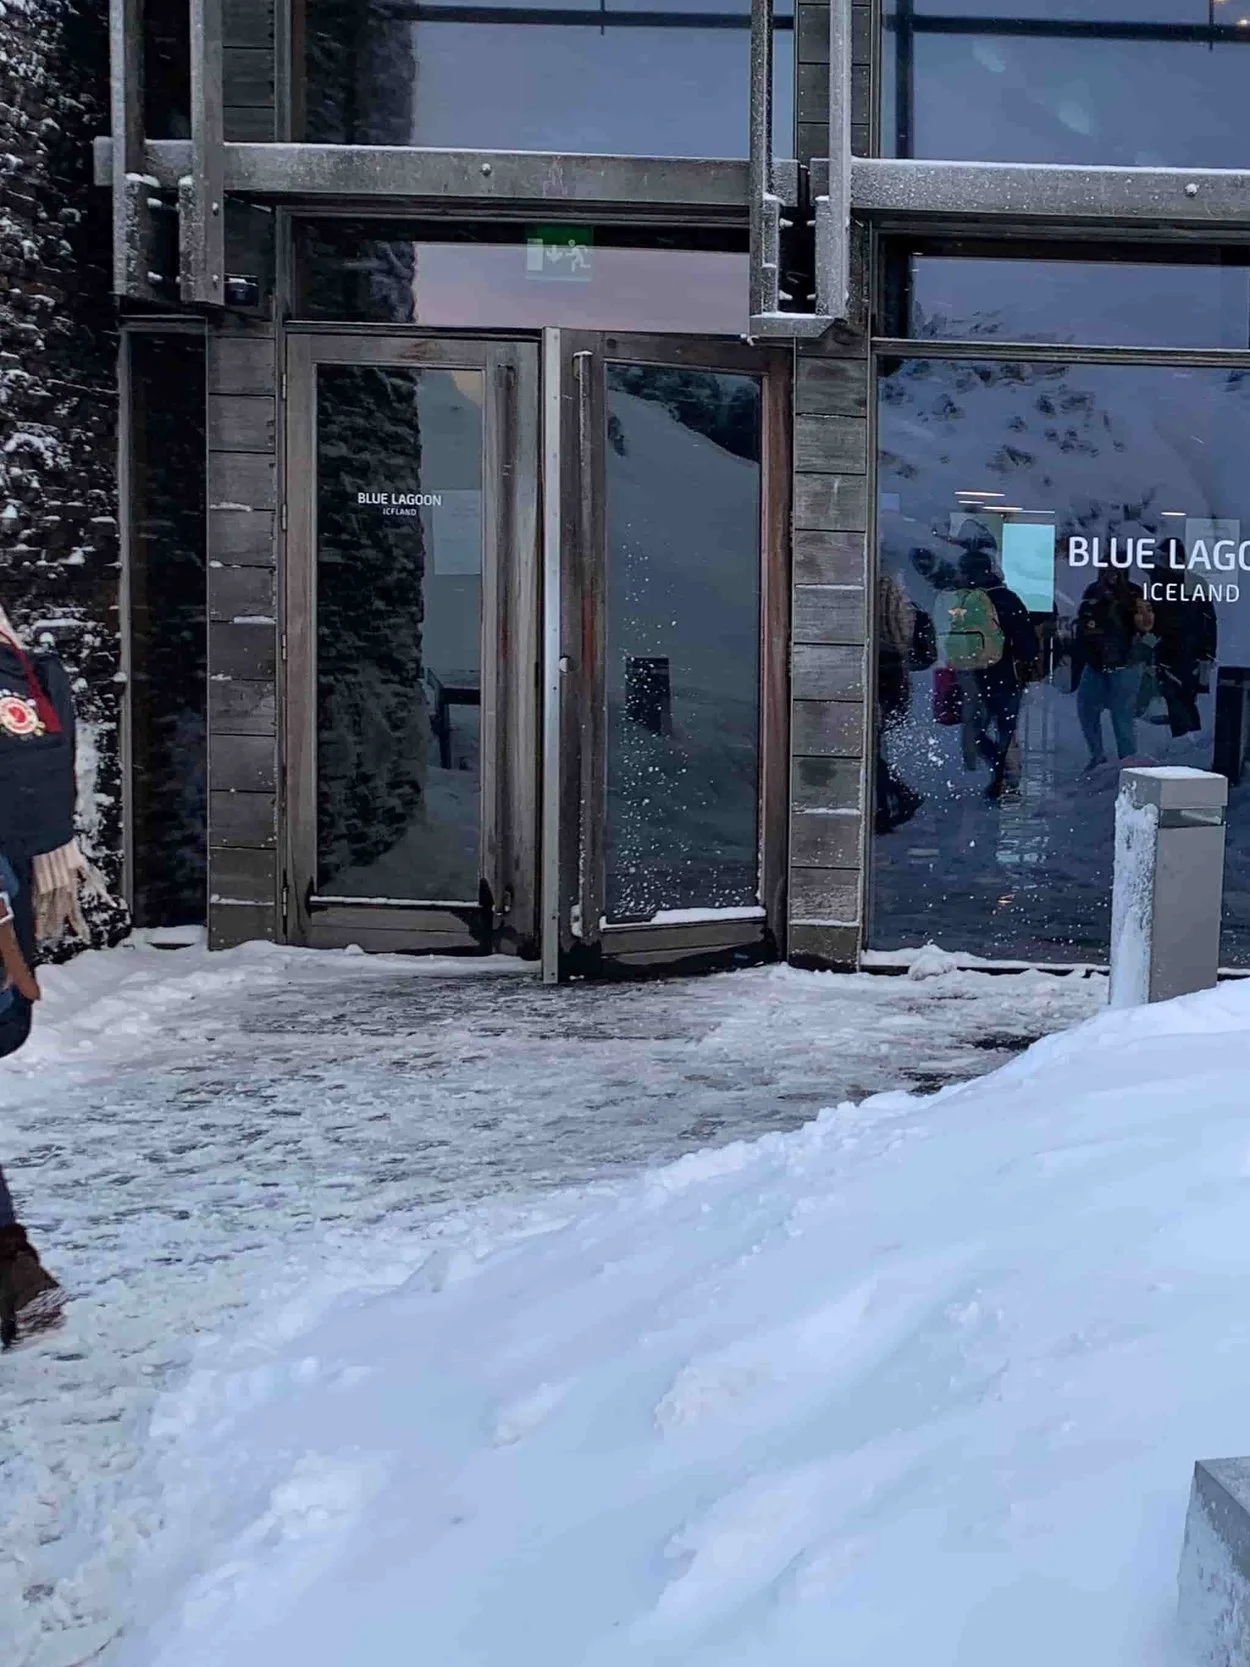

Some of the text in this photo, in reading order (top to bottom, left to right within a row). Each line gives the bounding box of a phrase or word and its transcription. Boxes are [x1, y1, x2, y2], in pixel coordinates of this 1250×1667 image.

[357, 492, 442, 506] BLUE LAGOON
[1068, 536, 1156, 569] BLUE
[1143, 582, 1240, 603] ICELAND
